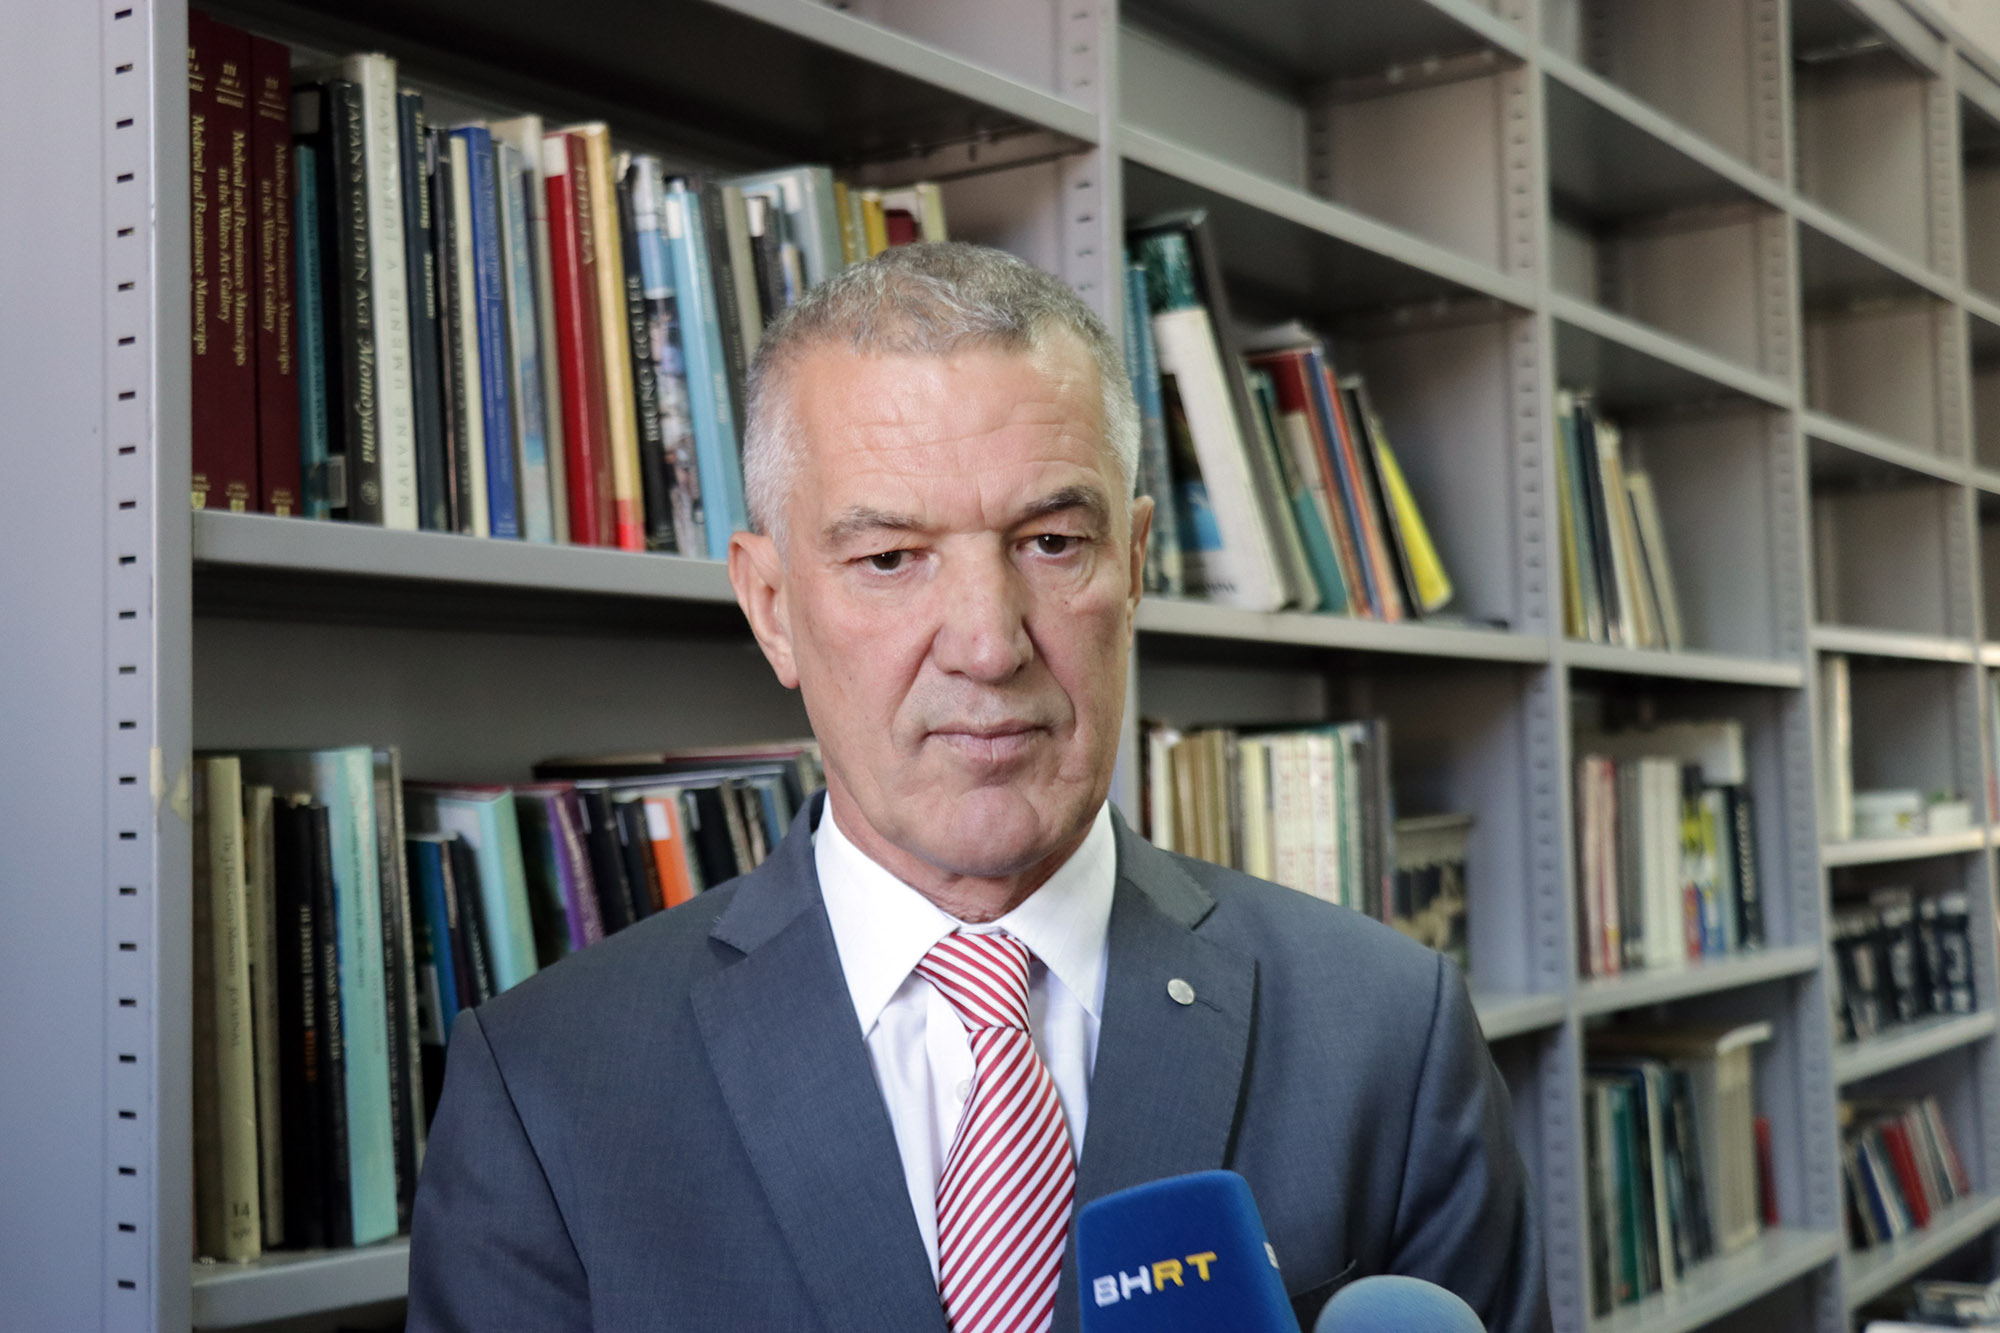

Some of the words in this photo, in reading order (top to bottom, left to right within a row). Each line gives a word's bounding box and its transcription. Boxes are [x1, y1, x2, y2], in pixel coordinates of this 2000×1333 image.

[192, 115, 205, 171] Medieval
[233, 130, 245, 188] Medieval
[192, 173, 205, 198] and
[218, 167, 229, 181] in
[219, 183, 230, 205] the
[274, 144, 286, 201] Medieval
[219, 207, 231, 249] Walters
[234, 189, 246, 213] and
[194, 201, 206, 276] Renaissance
[220, 251, 232, 273] Art
[235, 216, 247, 289] Renaissance
[278, 227, 290, 299] Renaissance
[352, 189, 368, 282] GOLDEN
[216, 276, 232, 323] Gallery
[264, 262, 276, 284] Art
[192, 279, 208, 356] Manuscripts
[232, 292, 247, 366] Manuscripts
[262, 287, 277, 334] Gallery
[355, 289, 370, 329] AGE
[278, 302, 292, 374] Manuscripts
[354, 338, 377, 464] Momoyama
[1092, 1250, 1218, 1308] BHRT
